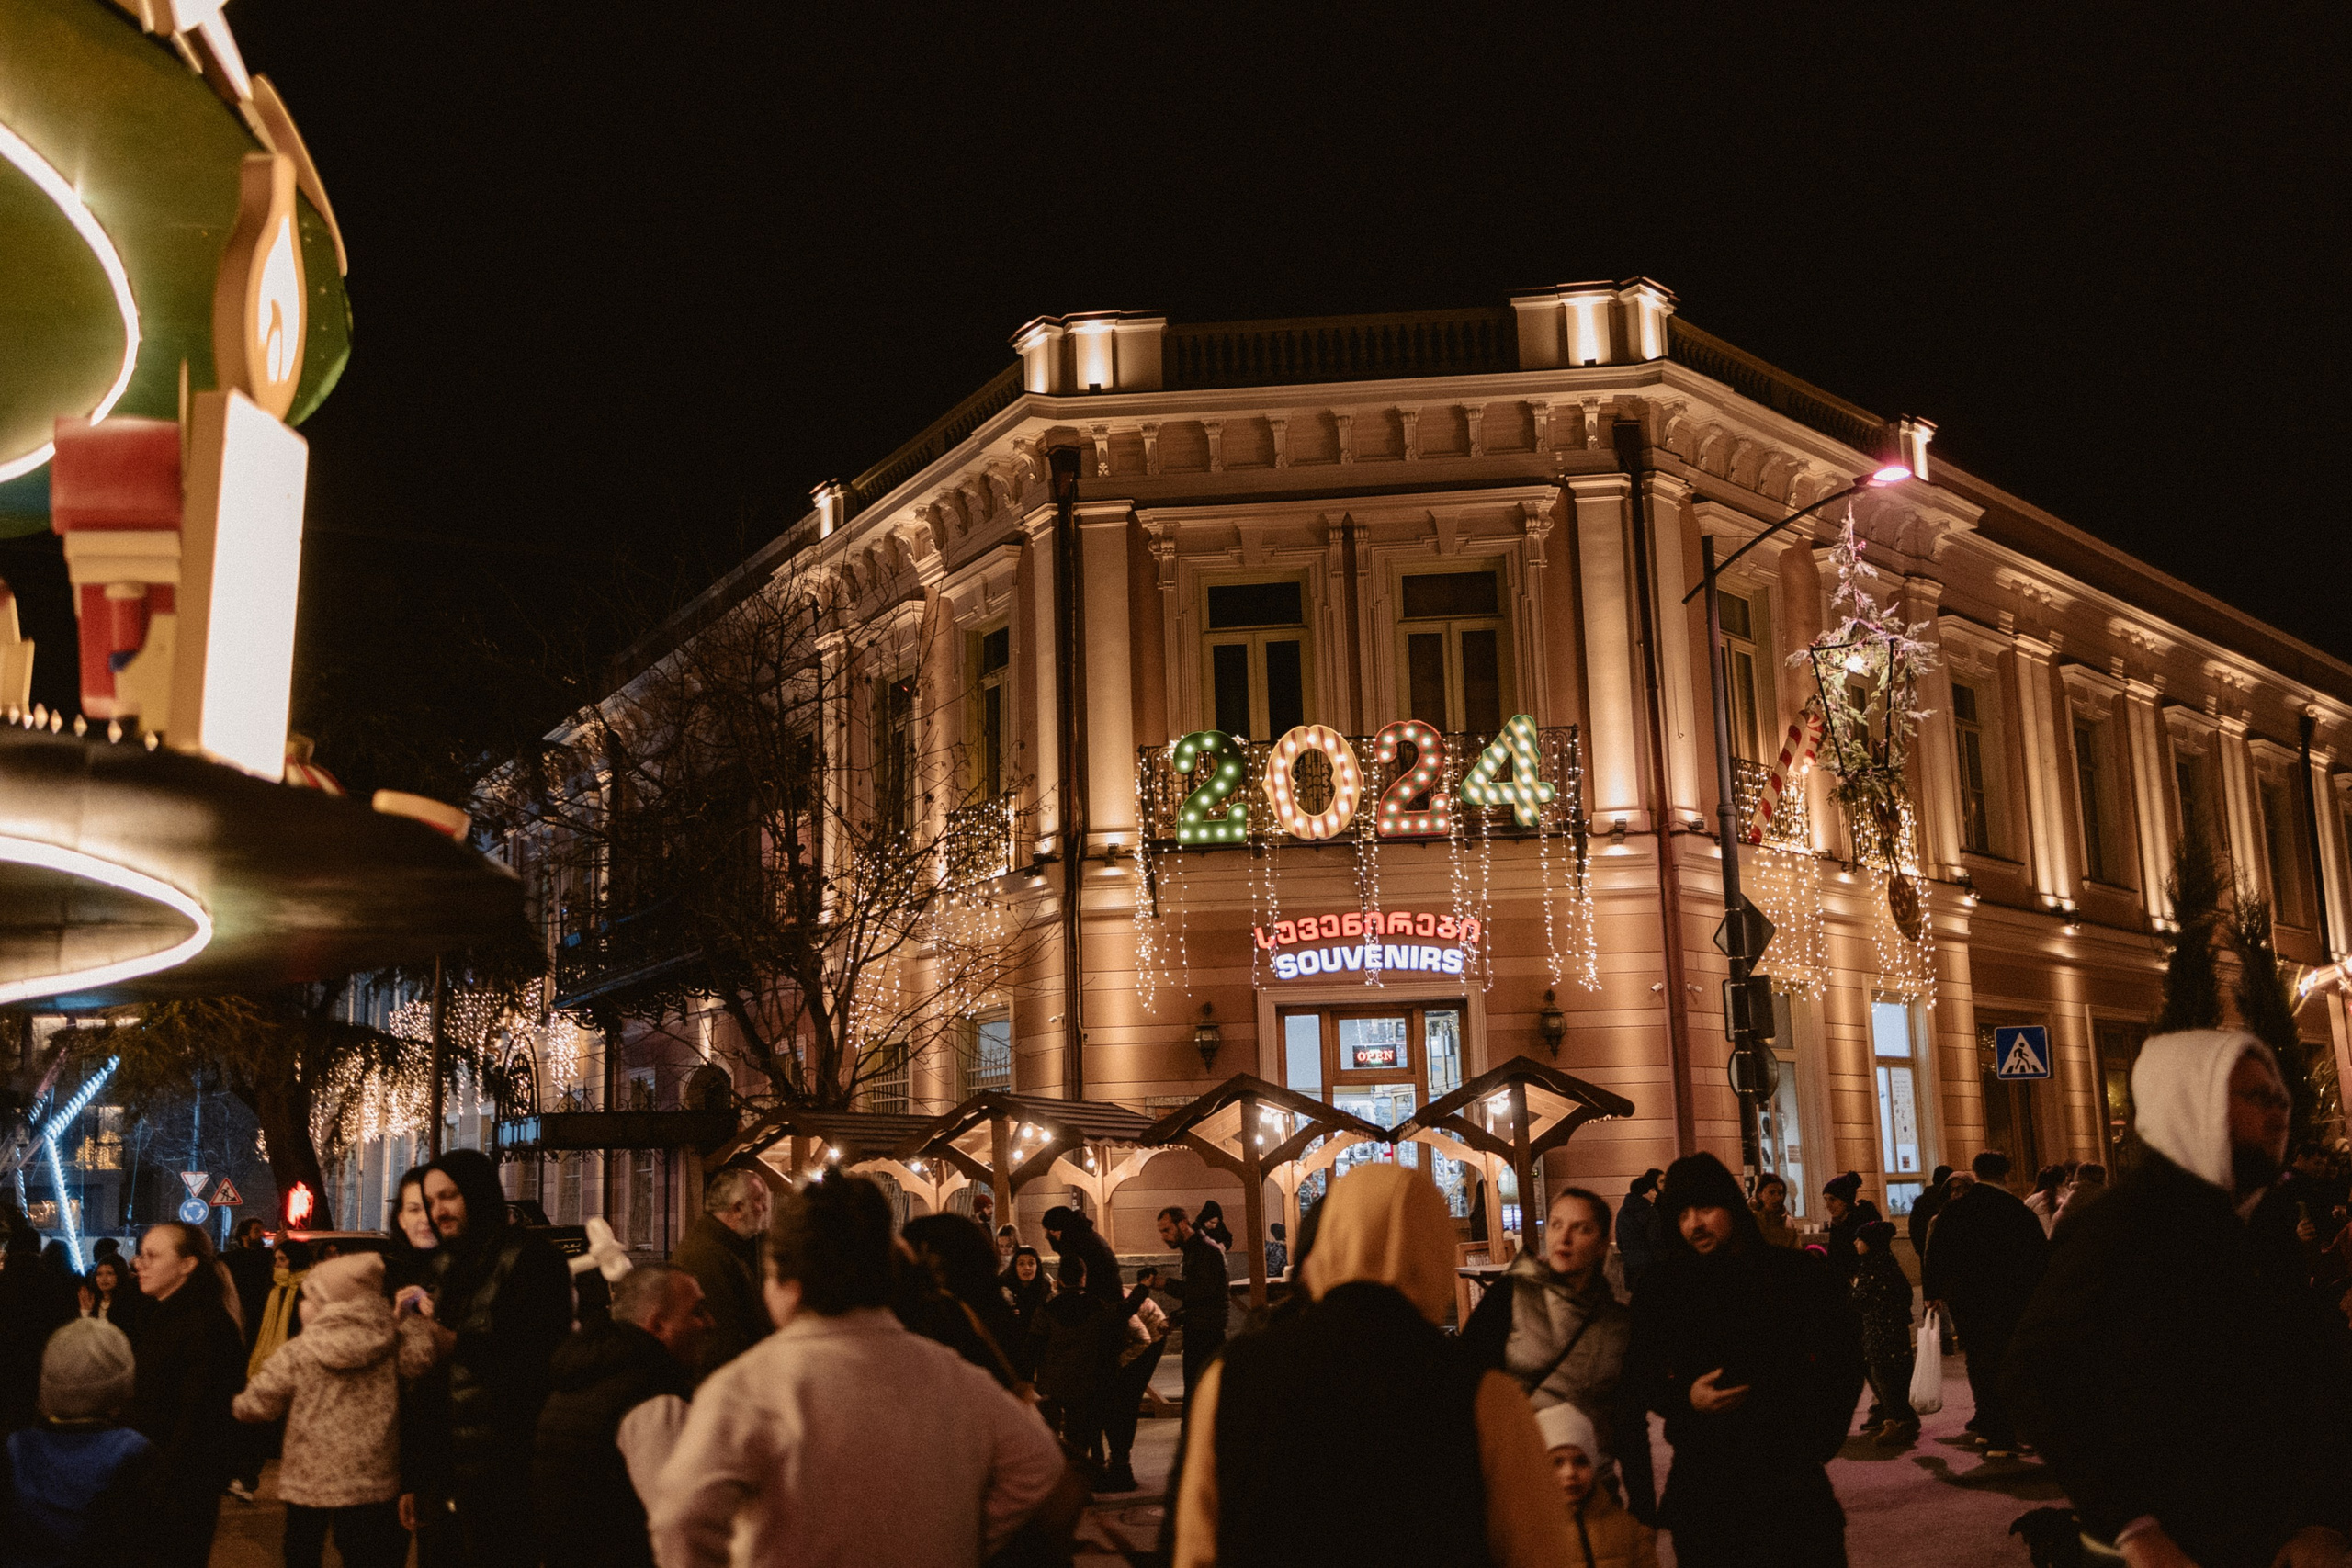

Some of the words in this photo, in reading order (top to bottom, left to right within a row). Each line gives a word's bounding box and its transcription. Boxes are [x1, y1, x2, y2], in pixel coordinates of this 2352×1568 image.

[1173, 715, 1555, 843] 2024
[1255, 911, 1481, 949] სუვენირები
[1276, 945, 1464, 979] SOUVENIRS
[1356, 1050, 1394, 1064] OPEN
